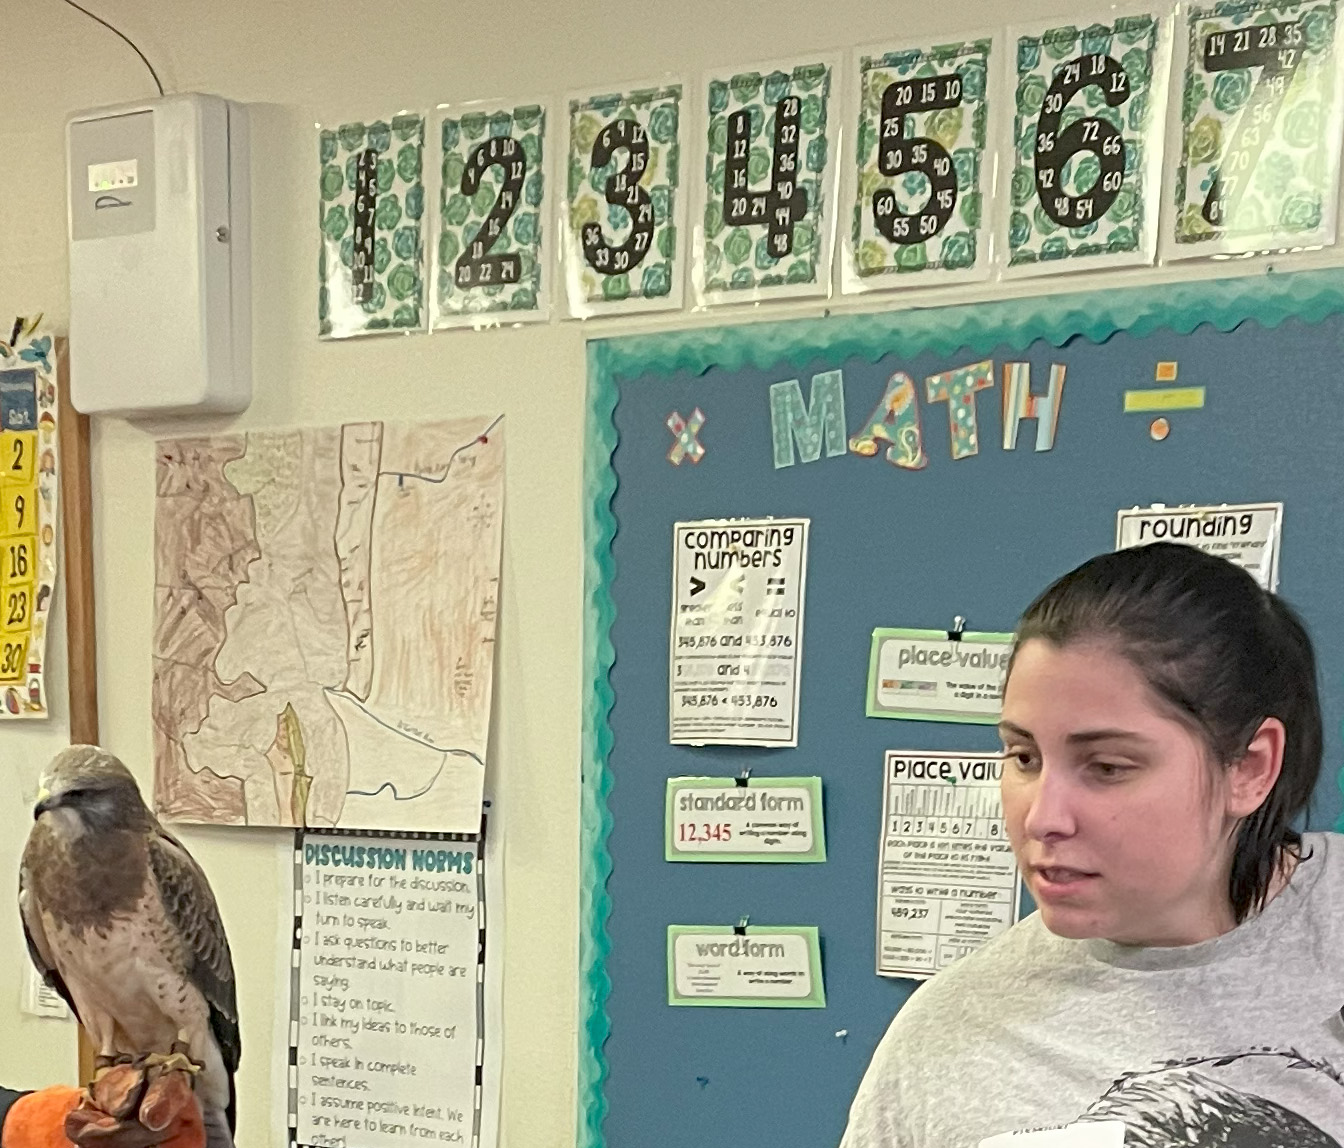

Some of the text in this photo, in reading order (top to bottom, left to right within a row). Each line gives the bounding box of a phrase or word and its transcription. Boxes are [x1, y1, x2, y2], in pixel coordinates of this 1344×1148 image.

[1209, 26, 1276, 56] 14 21 28
[1063, 55, 1105, 84] 24 18
[896, 80, 960, 106] 20 15 10
[1110, 72, 1126, 92] 12
[1045, 94, 1062, 113] 30
[884, 118, 899, 137] 25
[1082, 121, 1100, 143] 72
[1034, 53, 1131, 227] 6
[1038, 132, 1054, 152] 36
[1103, 136, 1120, 155] 66
[873, 73, 963, 244] 5
[886, 144, 927, 169] 30 35
[934, 158, 949, 176] 40
[723, 96, 807, 258] 4
[1039, 169, 1054, 188] 42
[1103, 172, 1122, 191] 60
[582, 119, 654, 275] 3
[877, 196, 893, 216] 60
[457, 136, 526, 289] 2
[1076, 199, 1093, 219] 54
[354, 149, 376, 301] 1
[894, 216, 936, 236] 55 50
[769, 360, 1066, 470] MATH
[12, 439, 23, 470] 2
[16, 496, 24, 528] 9
[1140, 514, 1252, 539] rounding
[685, 528, 794, 549] comparing
[10, 544, 27, 577] 16
[695, 549, 782, 569] numbers
[7, 592, 26, 625] 23
[1, 643, 22, 673] 30
[898, 645, 951, 669] place
[960, 762, 1003, 780] valu
[680, 792, 803, 811] standard form
[679, 823, 731, 843] 12,345
[904, 821, 910, 833] 2
[953, 822, 959, 834] 6
[965, 823, 972, 835] 7
[991, 825, 998, 835] 8
[306, 844, 473, 874] DISCUSSION NORMS
[323, 874, 364, 888] prepare
[369, 874, 385, 887] for
[390, 875, 406, 889] the
[323, 891, 474, 919] listen carefully and wait my
[316, 911, 340, 926] turn
[344, 914, 354, 927] to
[324, 935, 449, 954] ask questions to better
[696, 939, 785, 957] word form
[314, 955, 466, 977] understand what people are
